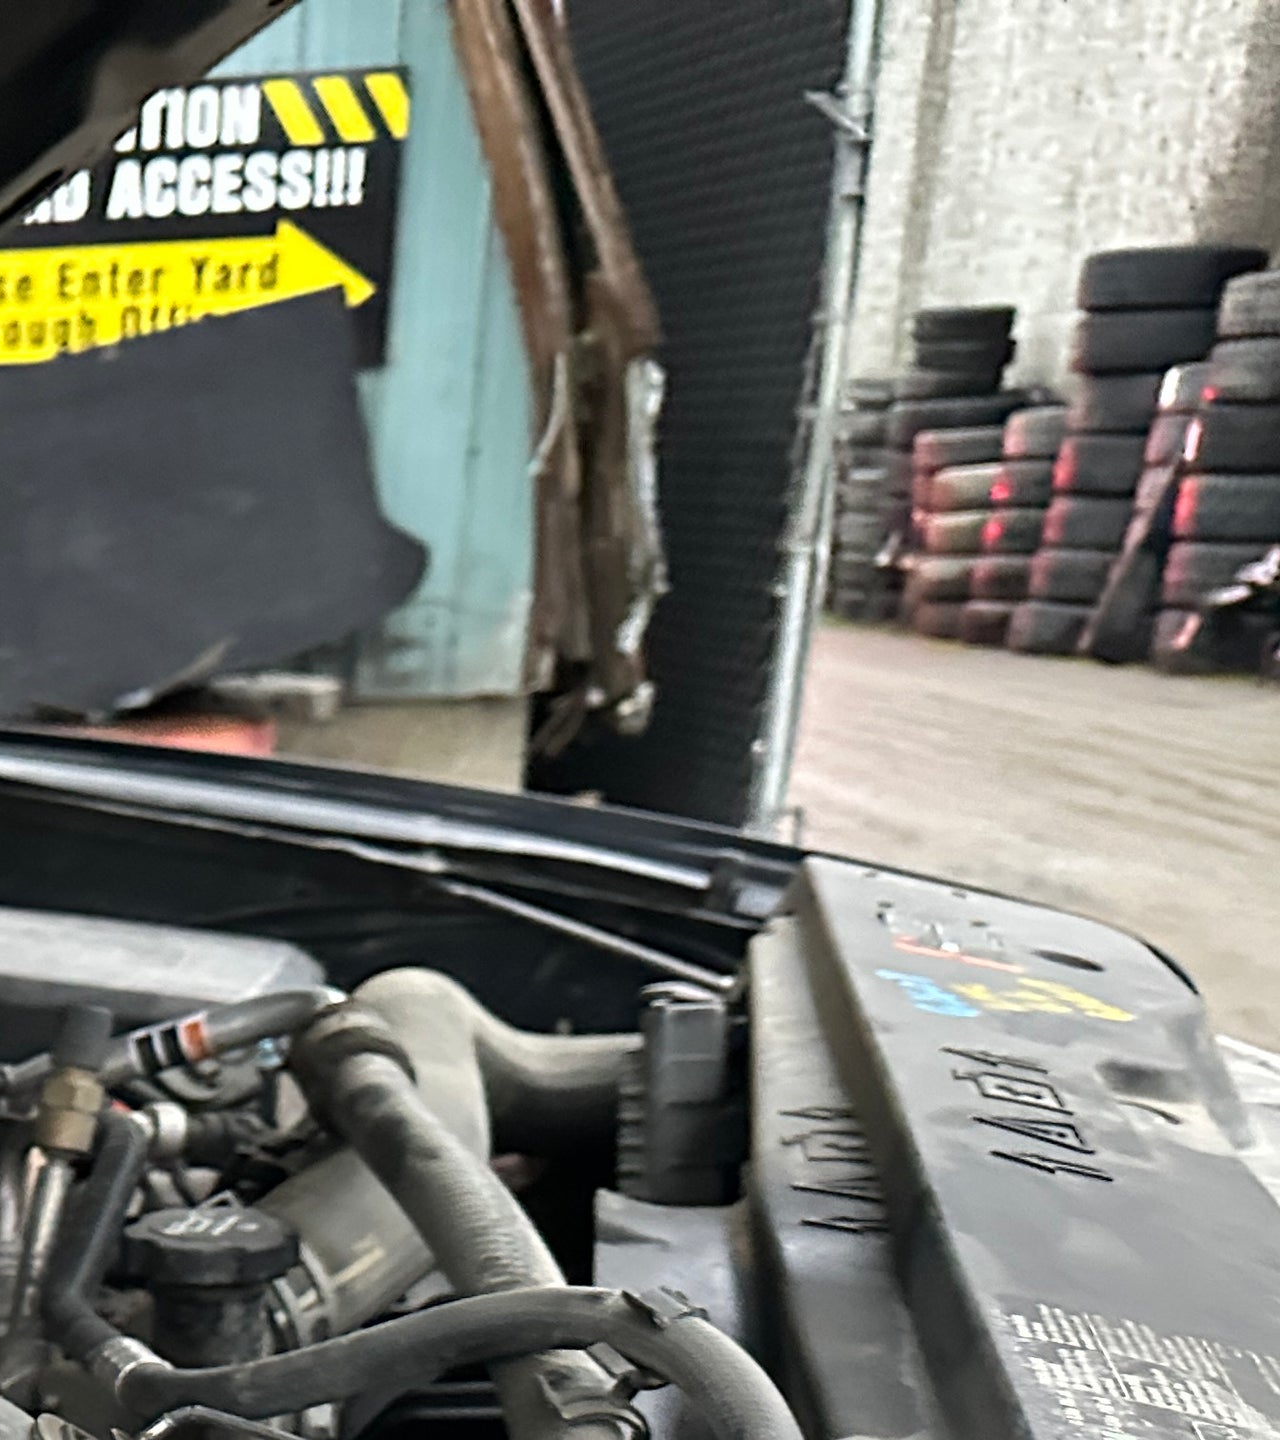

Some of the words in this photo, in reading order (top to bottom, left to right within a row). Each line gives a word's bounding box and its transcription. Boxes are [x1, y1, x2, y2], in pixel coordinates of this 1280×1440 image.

[114, 82, 261, 153] TION
[106, 146, 367, 220] ACCESS!!!
[58, 262, 163, 302] Enter
[191, 253, 280, 293] Yard
